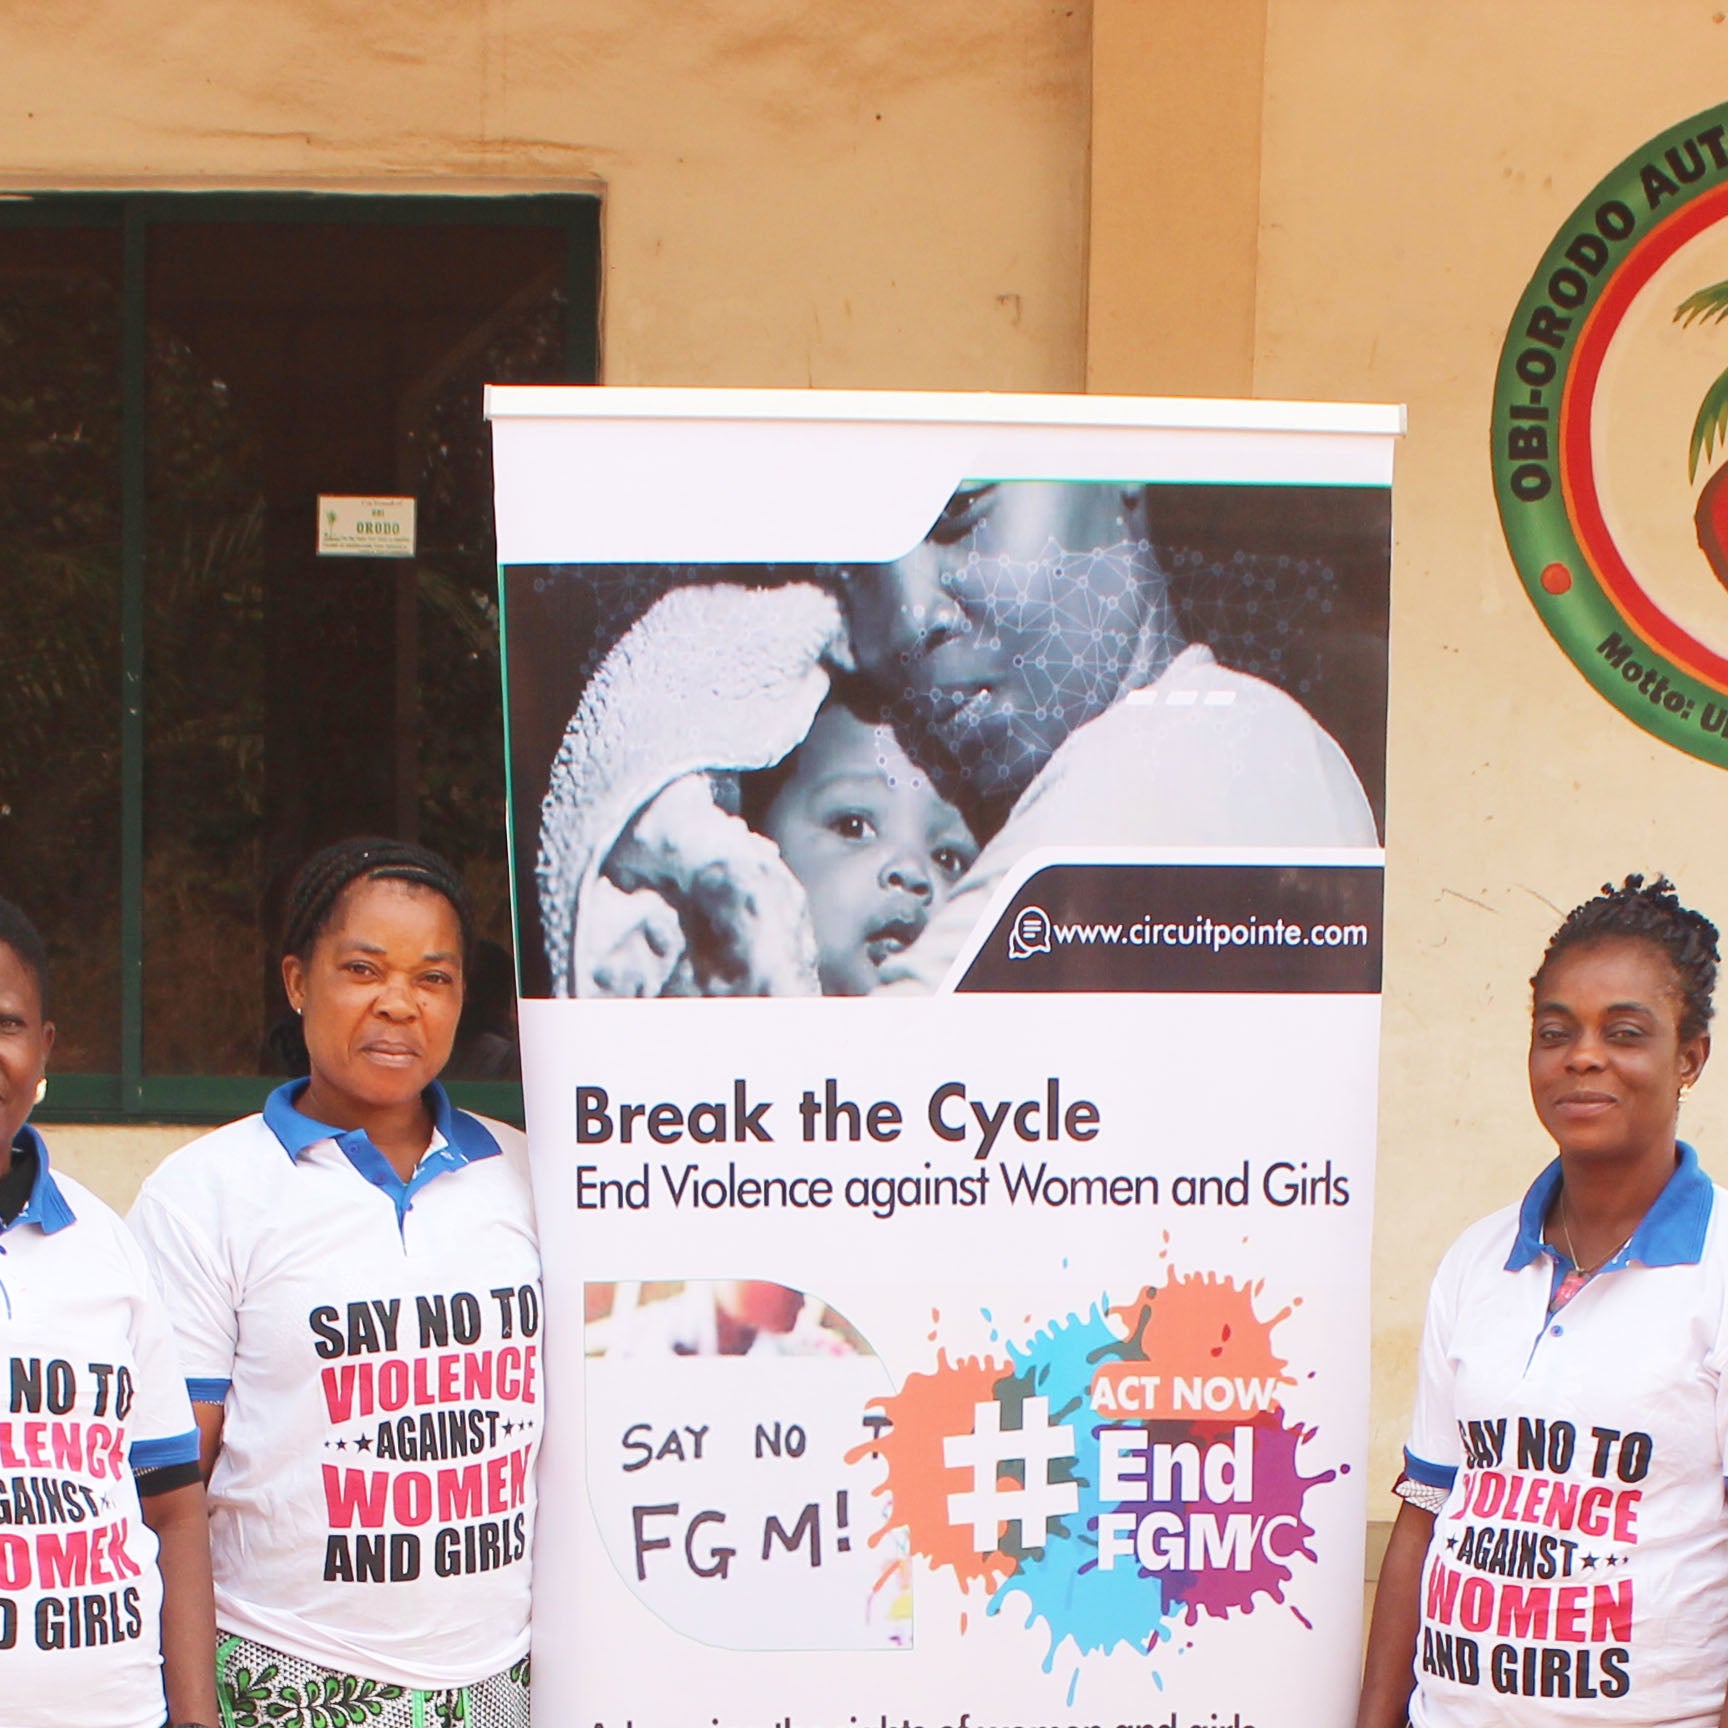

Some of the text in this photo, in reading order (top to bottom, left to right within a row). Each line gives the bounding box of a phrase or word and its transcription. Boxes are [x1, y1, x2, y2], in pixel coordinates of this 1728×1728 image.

[1508, 200, 1635, 502] OBI-ORODO
[356, 521, 400, 535] ORODO
[1596, 631, 1695, 720] Motto:
[1054, 915, 1369, 952] www.circuitpointe.com
[575, 1079, 1102, 1160] Break the Cycle
[576, 1160, 1351, 1219] End Violence against Women and Girls
[309, 1284, 538, 1360] SAY NO TO
[9, 1357, 77, 1416] NO
[88, 1362, 134, 1421] TO
[321, 1345, 536, 1424] VIOLENCE
[1088, 1374, 1277, 1413] ACT NOW
[376, 1409, 500, 1462] AGAINST
[621, 1415, 893, 1472] SAY NO T
[1517, 1416, 1576, 1474] NO
[1592, 1426, 1654, 1483] TO
[322, 1442, 533, 1529] WOMEN
[1448, 1470, 1643, 1545] OLENCE
[323, 1512, 526, 1583] AND GIRLS
[1098, 1513, 1300, 1572] FGM/C
[1456, 1526, 1579, 1580] AGAINST
[34, 1587, 142, 1651] GIRLS
[1427, 1554, 1634, 1643] WOMEN
[1422, 1626, 1630, 1699] AND GIRLS
